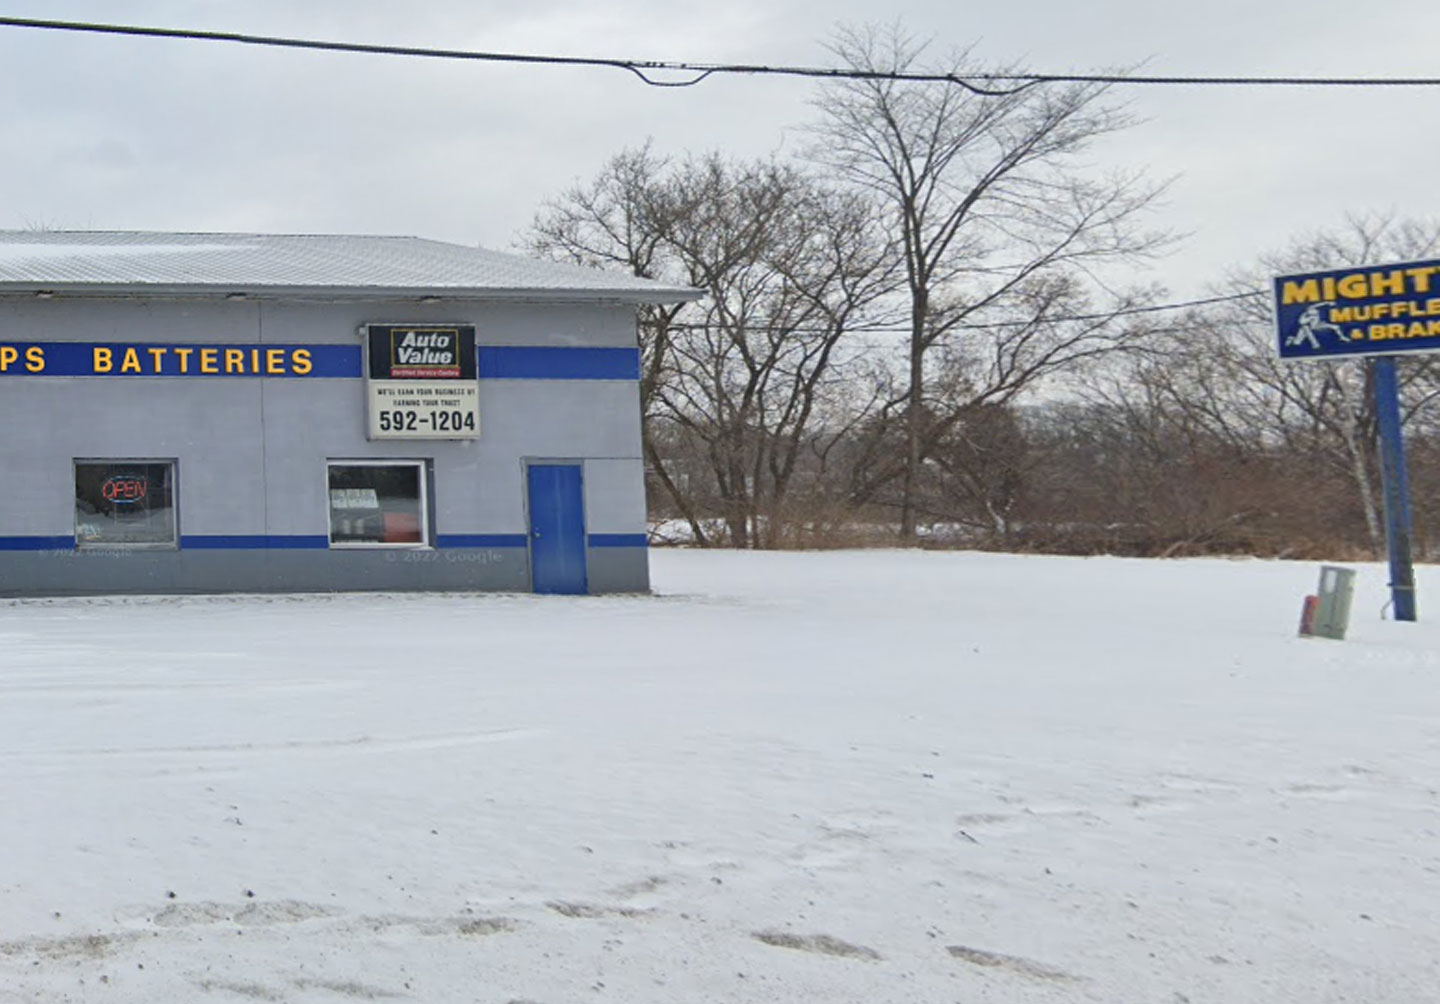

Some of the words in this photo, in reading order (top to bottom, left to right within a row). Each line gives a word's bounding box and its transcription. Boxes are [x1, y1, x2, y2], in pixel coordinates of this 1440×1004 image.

[1282, 266, 1440, 304] MIGHT
[1329, 298, 1440, 323] MUFFLE
[401, 331, 450, 348] Auto
[1350, 329, 1364, 340] &
[1369, 320, 1440, 341] BRAK
[93, 347, 314, 375] BATTERIES
[398, 347, 453, 364] Value
[380, 410, 475, 431] 592-1204
[103, 479, 147, 499] OPEN
